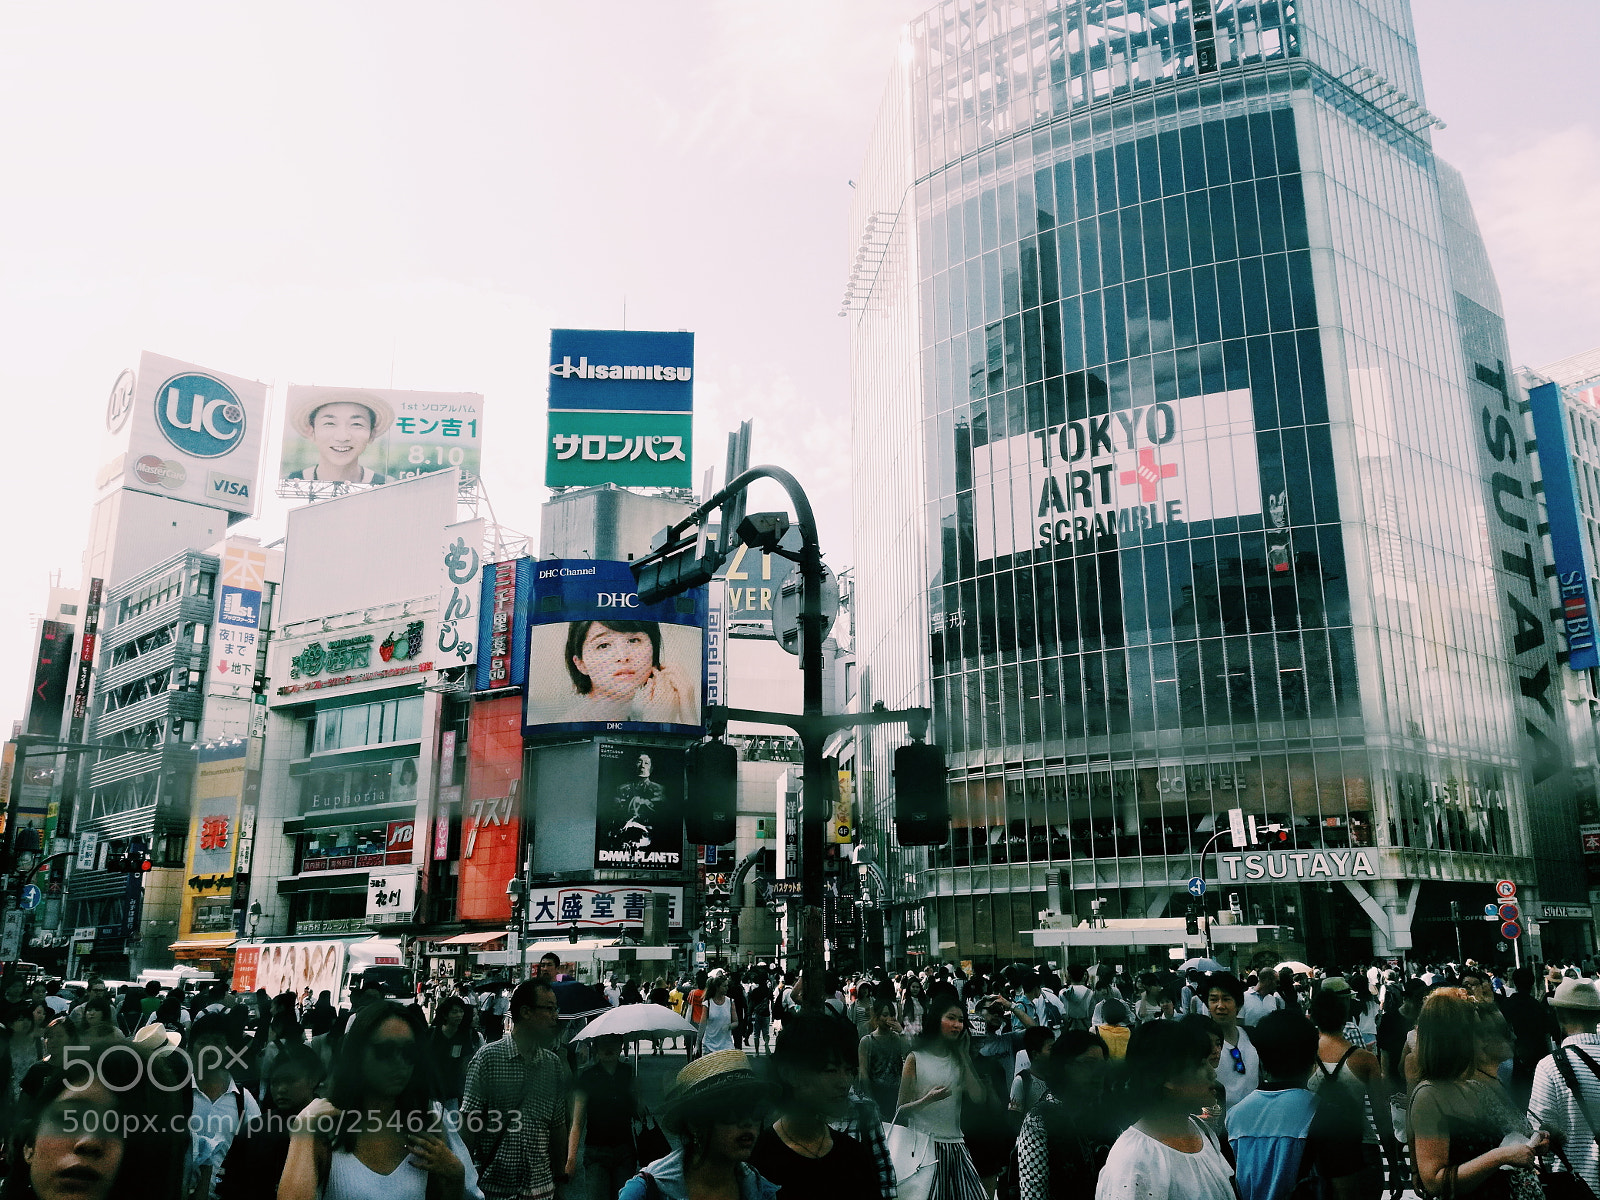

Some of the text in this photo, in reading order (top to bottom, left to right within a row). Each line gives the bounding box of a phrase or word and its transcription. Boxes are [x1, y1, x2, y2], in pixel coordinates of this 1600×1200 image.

[549, 356, 691, 381] Hisamitsu
[422, 402, 476, 414] ソロアルバム
[396, 416, 478, 438] モン吉1
[1033, 402, 1177, 468] TOKYO
[407, 444, 465, 466] 8.10
[552, 433, 686, 462] サロンパス
[135, 461, 186, 482] MasterCard
[213, 479, 249, 498] VISA
[1037, 463, 1117, 518] ART
[1038, 499, 1183, 549] SCRAMBLE
[223, 550, 265, 590] 本
[539, 566, 596, 579] DHC Channel
[1475, 360, 1562, 786] TSUTAYA
[438, 536, 479, 662] もんじゃ
[596, 592, 640, 608] DHC
[489, 564, 511, 681] 三千里薬品
[218, 628, 255, 645] 夜11時
[224, 642, 247, 656] まで
[231, 661, 252, 676] 地下
[606, 722, 623, 730] DHC
[1156, 775, 1247, 795] COFFEE
[312, 791, 385, 809] Euphoria
[200, 814, 230, 850] 薬
[388, 824, 414, 847] JTB
[786, 801, 798, 878] 洋服の青山
[838, 827, 849, 835] 4F
[1223, 850, 1375, 881] TSUTAYA
